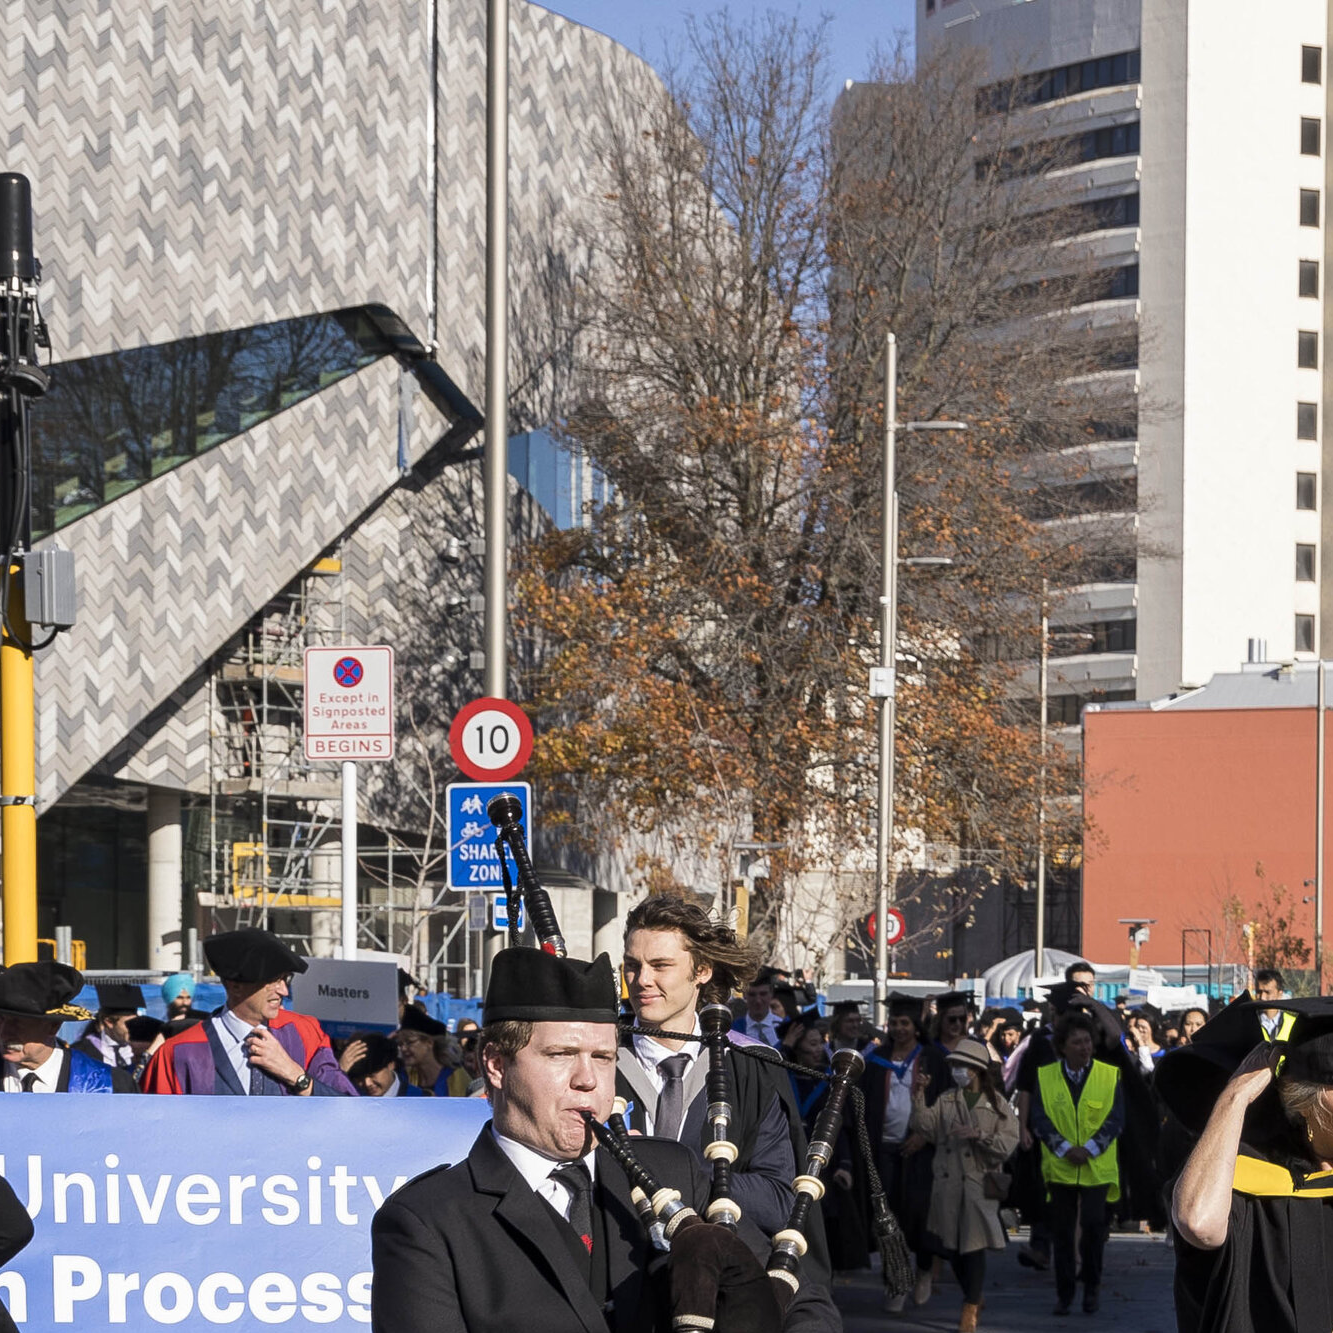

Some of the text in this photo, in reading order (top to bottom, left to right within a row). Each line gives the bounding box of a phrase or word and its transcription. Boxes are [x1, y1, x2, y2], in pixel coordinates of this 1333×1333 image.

[319, 693, 379, 706] Except in
[312, 706, 386, 720] Signposted
[330, 719, 368, 731] Areas
[315, 739, 383, 753] BEGINS
[475, 725, 509, 754] 10
[469, 865, 503, 881] ZON
[318, 984, 370, 999] Masters
